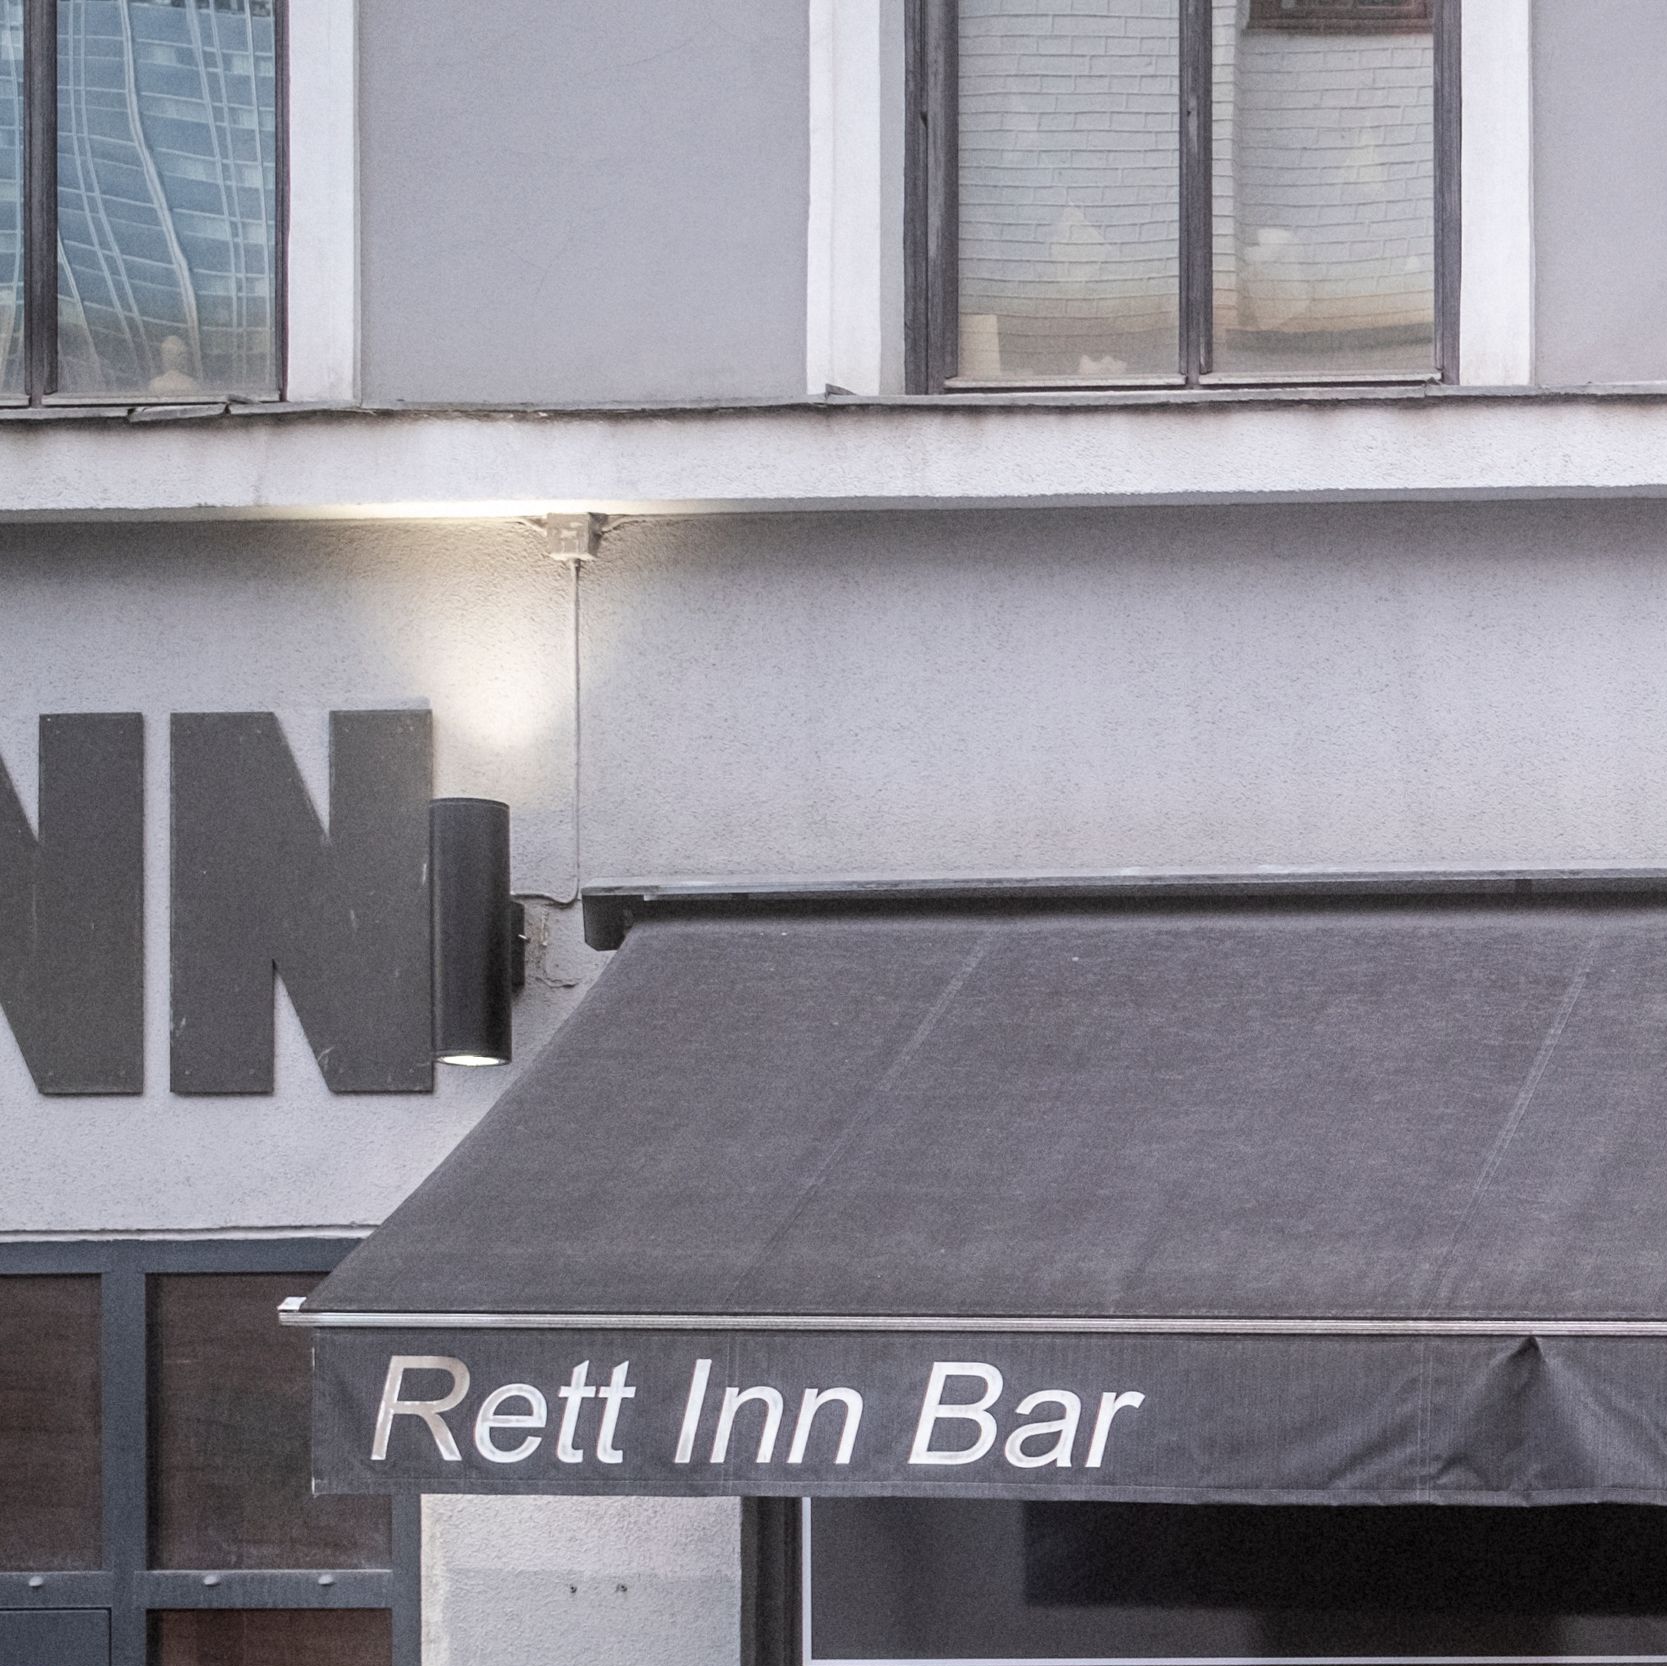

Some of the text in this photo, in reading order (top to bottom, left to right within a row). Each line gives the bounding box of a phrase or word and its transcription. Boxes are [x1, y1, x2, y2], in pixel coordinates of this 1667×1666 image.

[371, 1356, 1145, 1468] Rett Inn Bar
